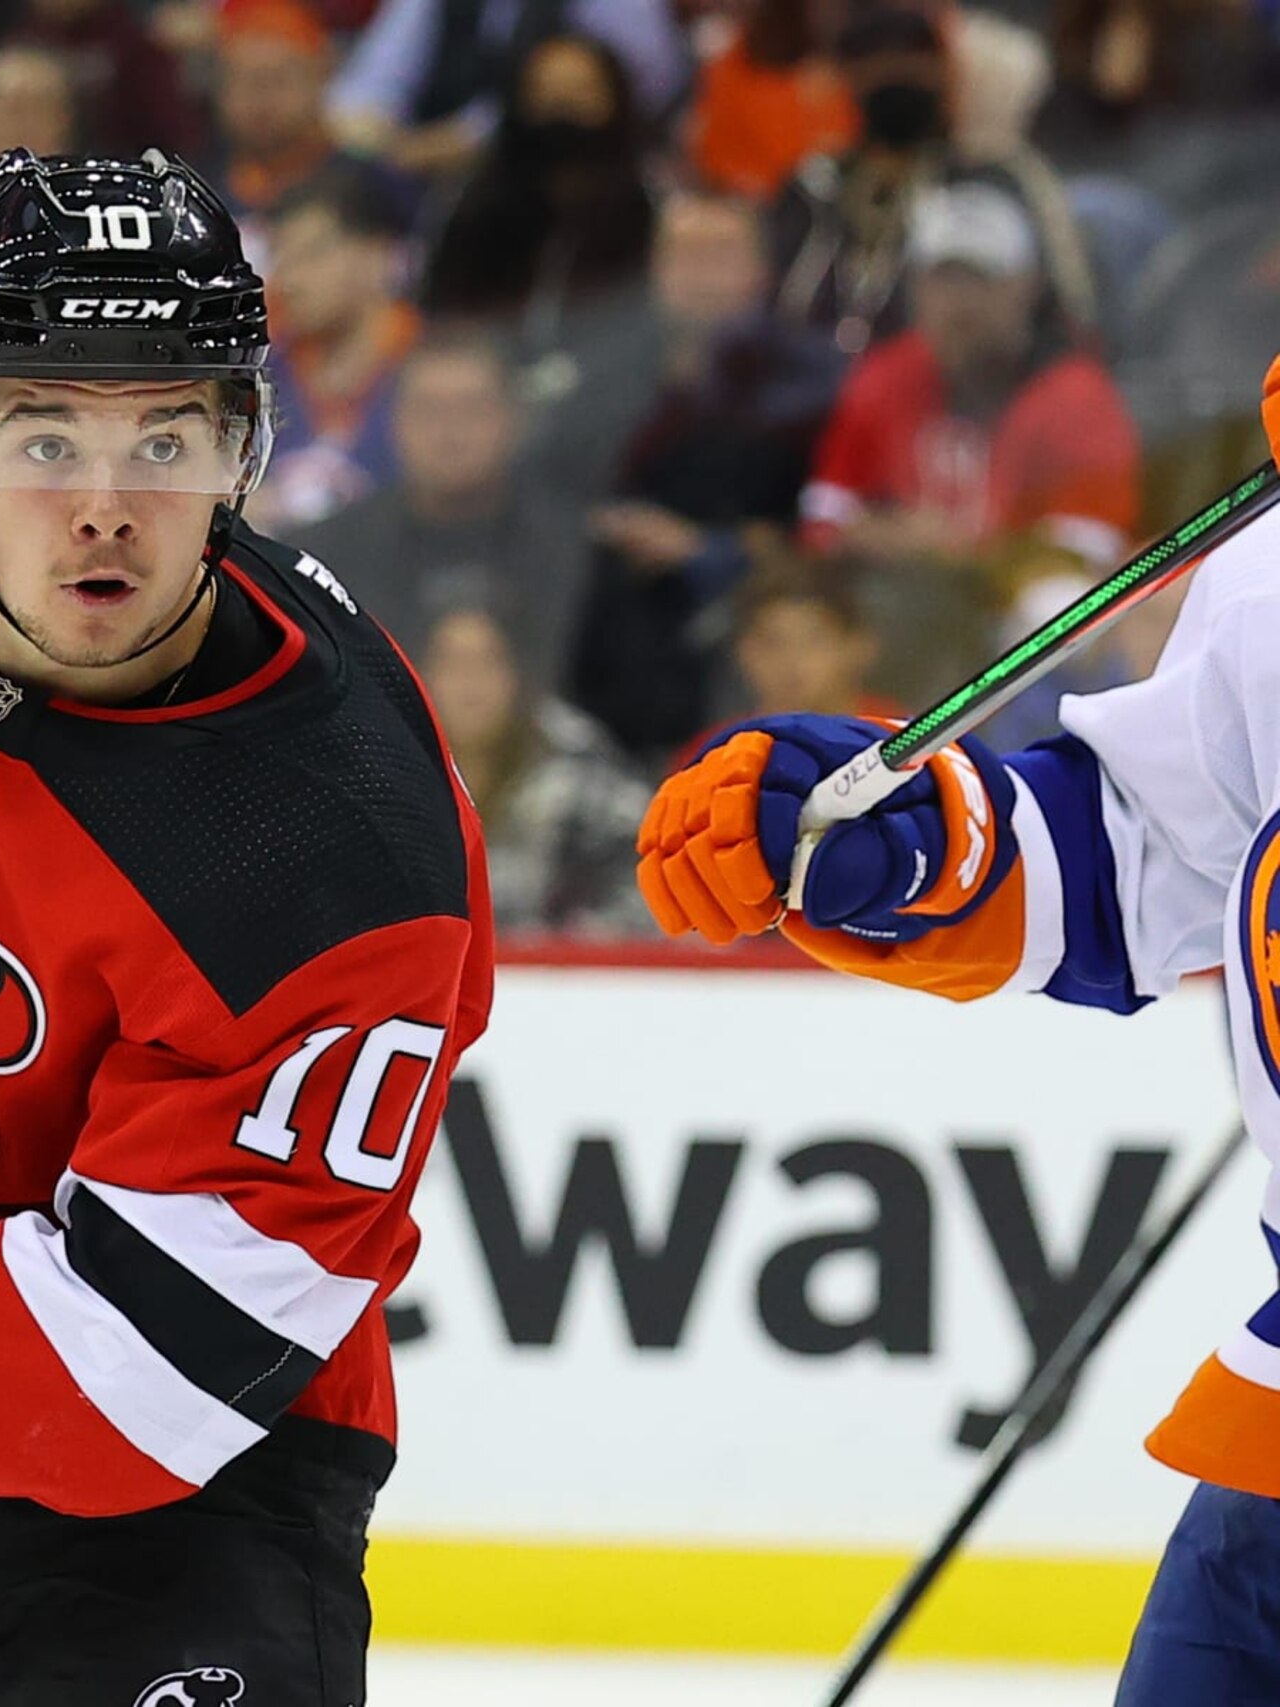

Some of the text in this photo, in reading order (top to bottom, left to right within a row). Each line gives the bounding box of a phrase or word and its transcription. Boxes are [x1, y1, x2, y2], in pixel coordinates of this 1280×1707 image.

[85, 205, 151, 249] 10
[60, 299, 181, 319] CCM
[232, 1014, 447, 1192] 10
[382, 1077, 1170, 1449] way
